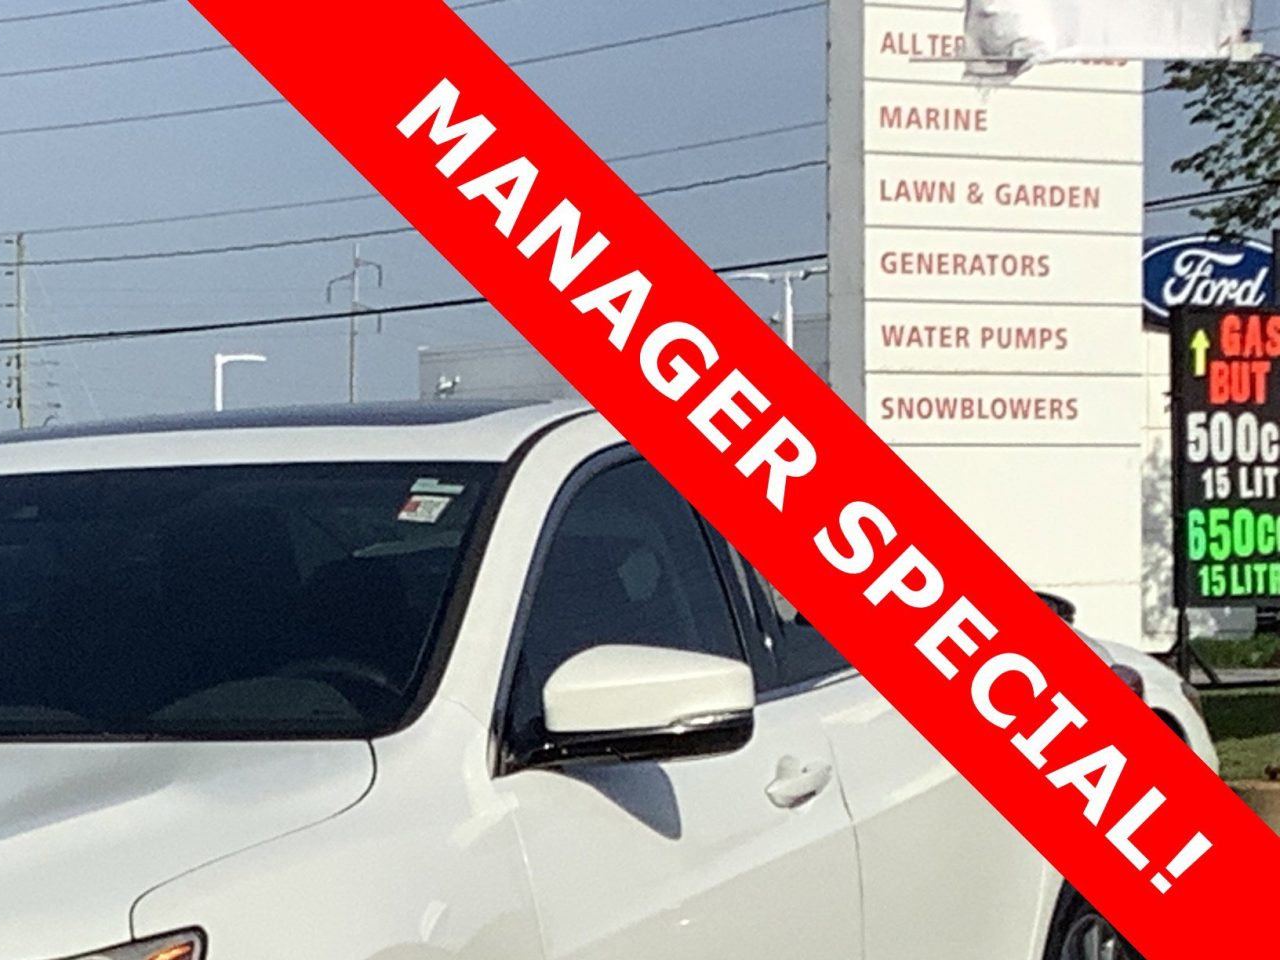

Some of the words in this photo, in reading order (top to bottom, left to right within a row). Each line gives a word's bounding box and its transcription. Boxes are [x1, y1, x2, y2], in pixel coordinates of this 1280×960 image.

[880, 32, 923, 55] ALL
[880, 106, 988, 132] MARINE
[880, 179, 956, 204] LAWN
[967, 182, 984, 204] &
[995, 183, 1100, 209] GARDEN
[880, 251, 1050, 277] GENERATORS
[1163, 248, 1269, 306] Ford
[881, 324, 969, 349] WATER
[980, 326, 1068, 351] PUMPS
[1210, 361, 1271, 404] BUT
[880, 397, 1079, 421] SNOWBLOWERS
[1201, 466, 1231, 499] 15
[1188, 507, 1280, 560] 650c
[1199, 564, 1226, 596] 15
